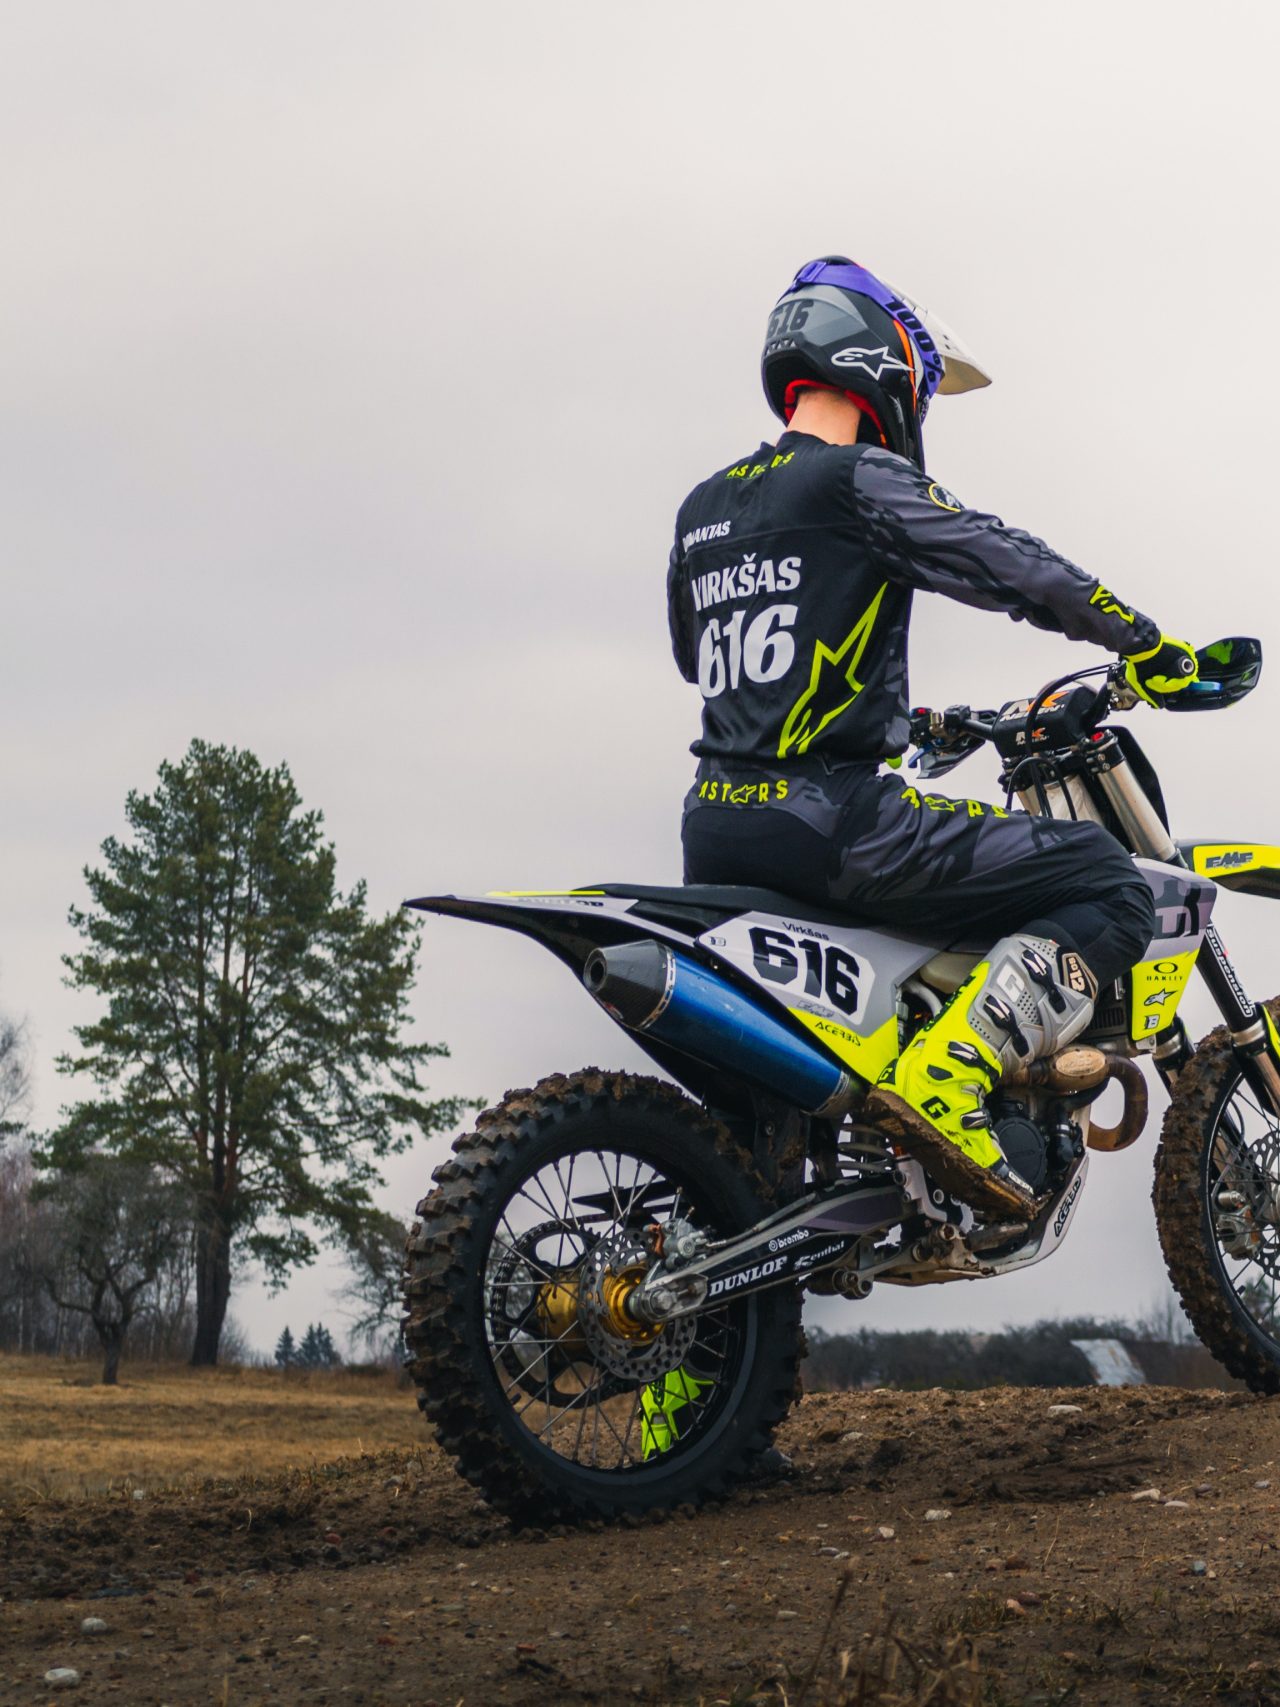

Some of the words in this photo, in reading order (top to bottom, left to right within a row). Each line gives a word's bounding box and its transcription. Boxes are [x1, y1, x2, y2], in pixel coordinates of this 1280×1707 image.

[885, 296, 945, 383] 100%
[692, 553, 802, 612] VIRKŠAS
[699, 604, 799, 698] 616
[1206, 852, 1253, 868] FMF
[748, 926, 860, 1016] 616
[777, 1229, 810, 1249] brembo
